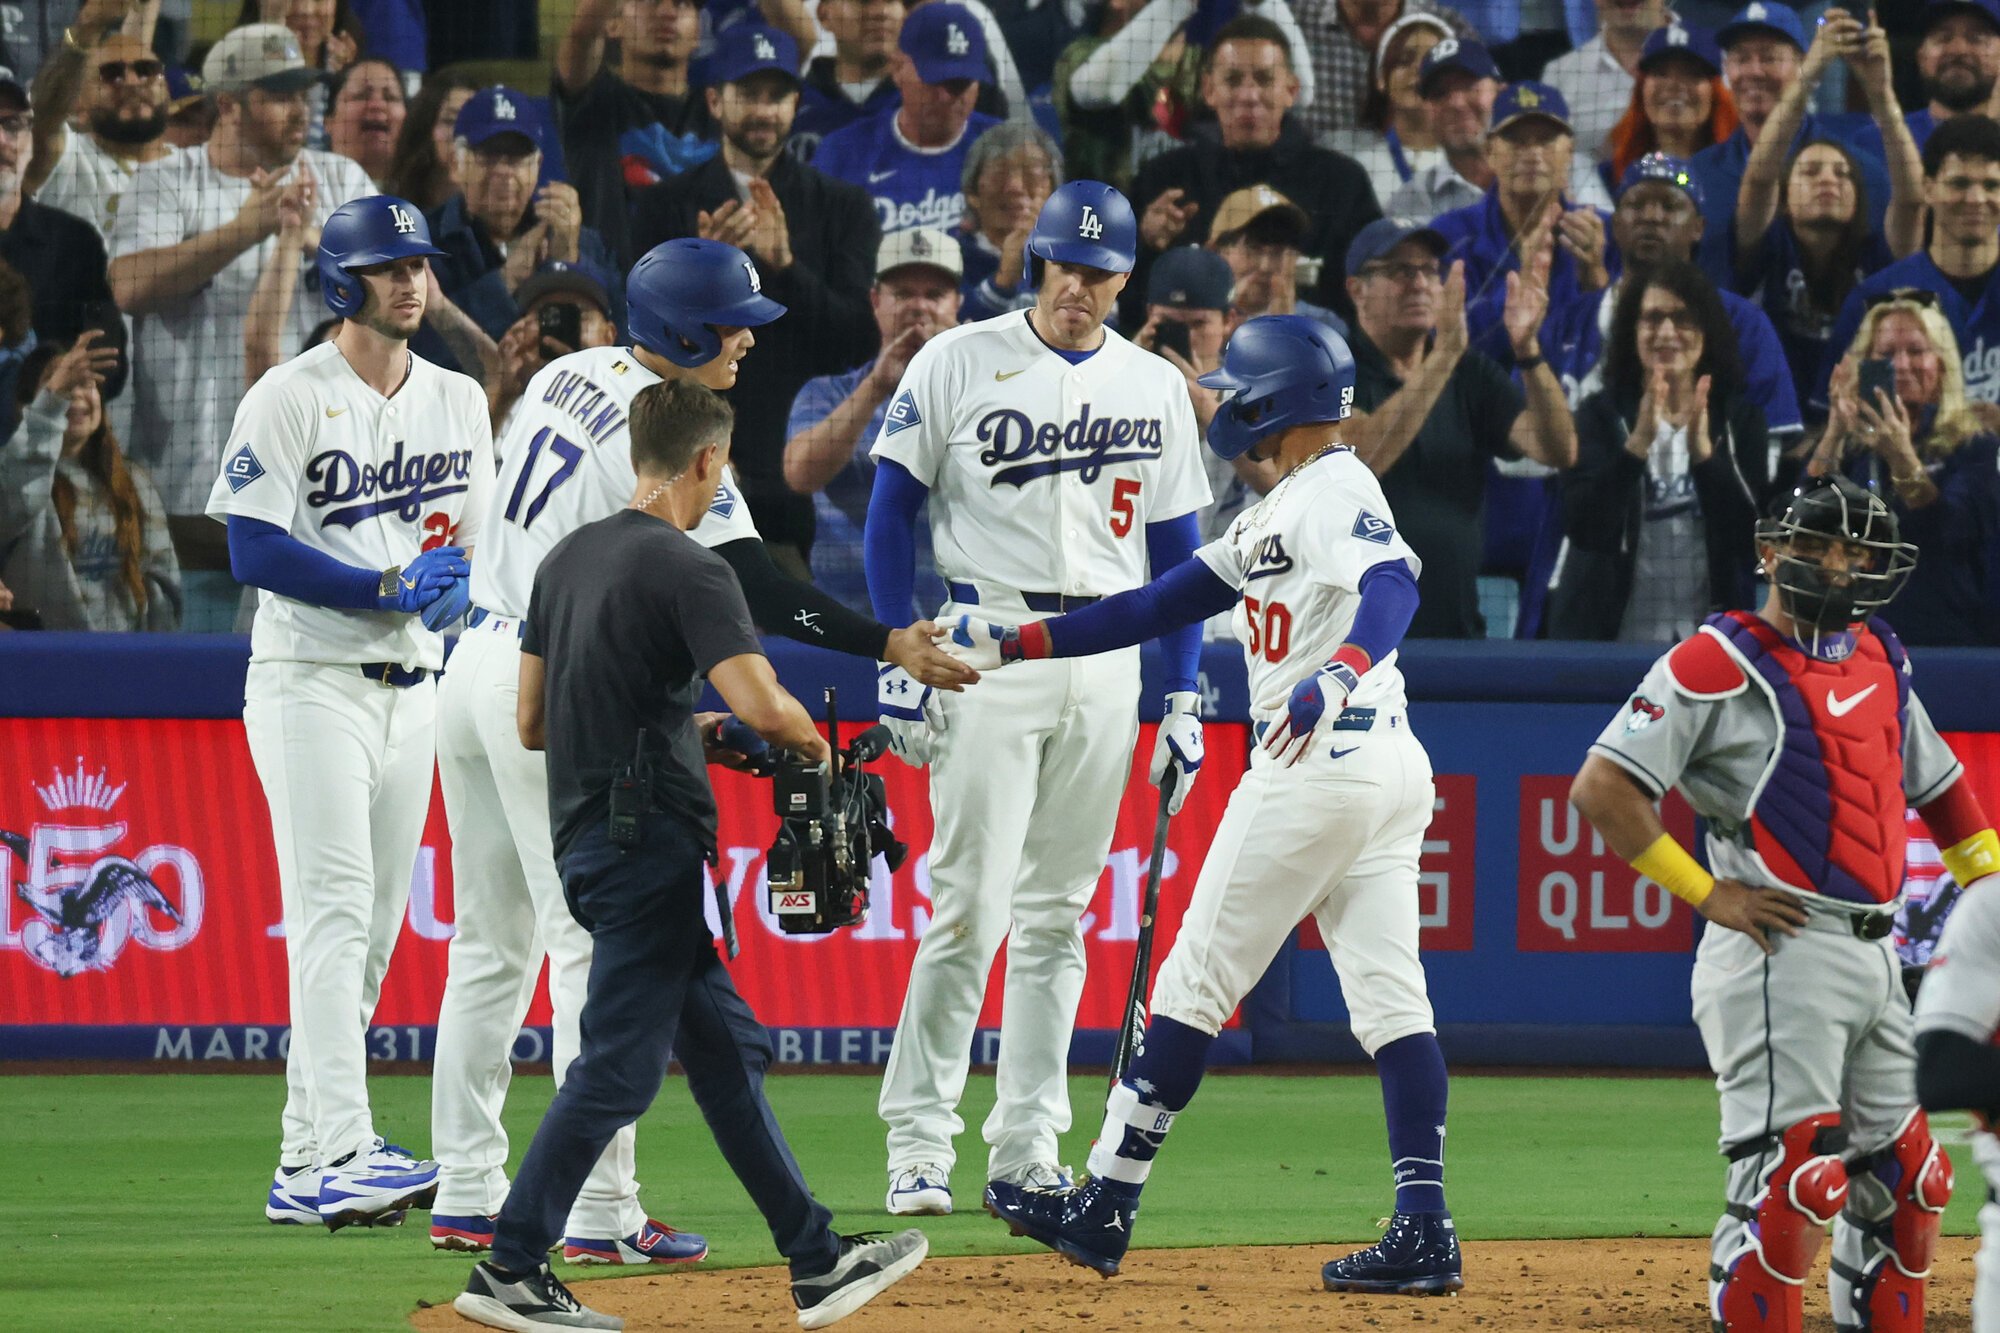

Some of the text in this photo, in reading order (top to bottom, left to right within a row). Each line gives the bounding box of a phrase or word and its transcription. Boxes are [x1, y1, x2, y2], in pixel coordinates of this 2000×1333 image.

[388, 204, 416, 233] LA
[1079, 206, 1103, 240] LA
[744, 262, 761, 293] LA
[542, 369, 628, 447] OHTANI
[1341, 386, 1354, 405] 50
[976, 404, 1163, 485] Dodgers
[504, 425, 586, 530] 17
[1109, 478, 1142, 539] 5
[421, 511, 460, 553] 2
[1244, 594, 1292, 663] 50
[780, 894, 811, 907] AVS
[154, 1027, 420, 1061] MAR 31
